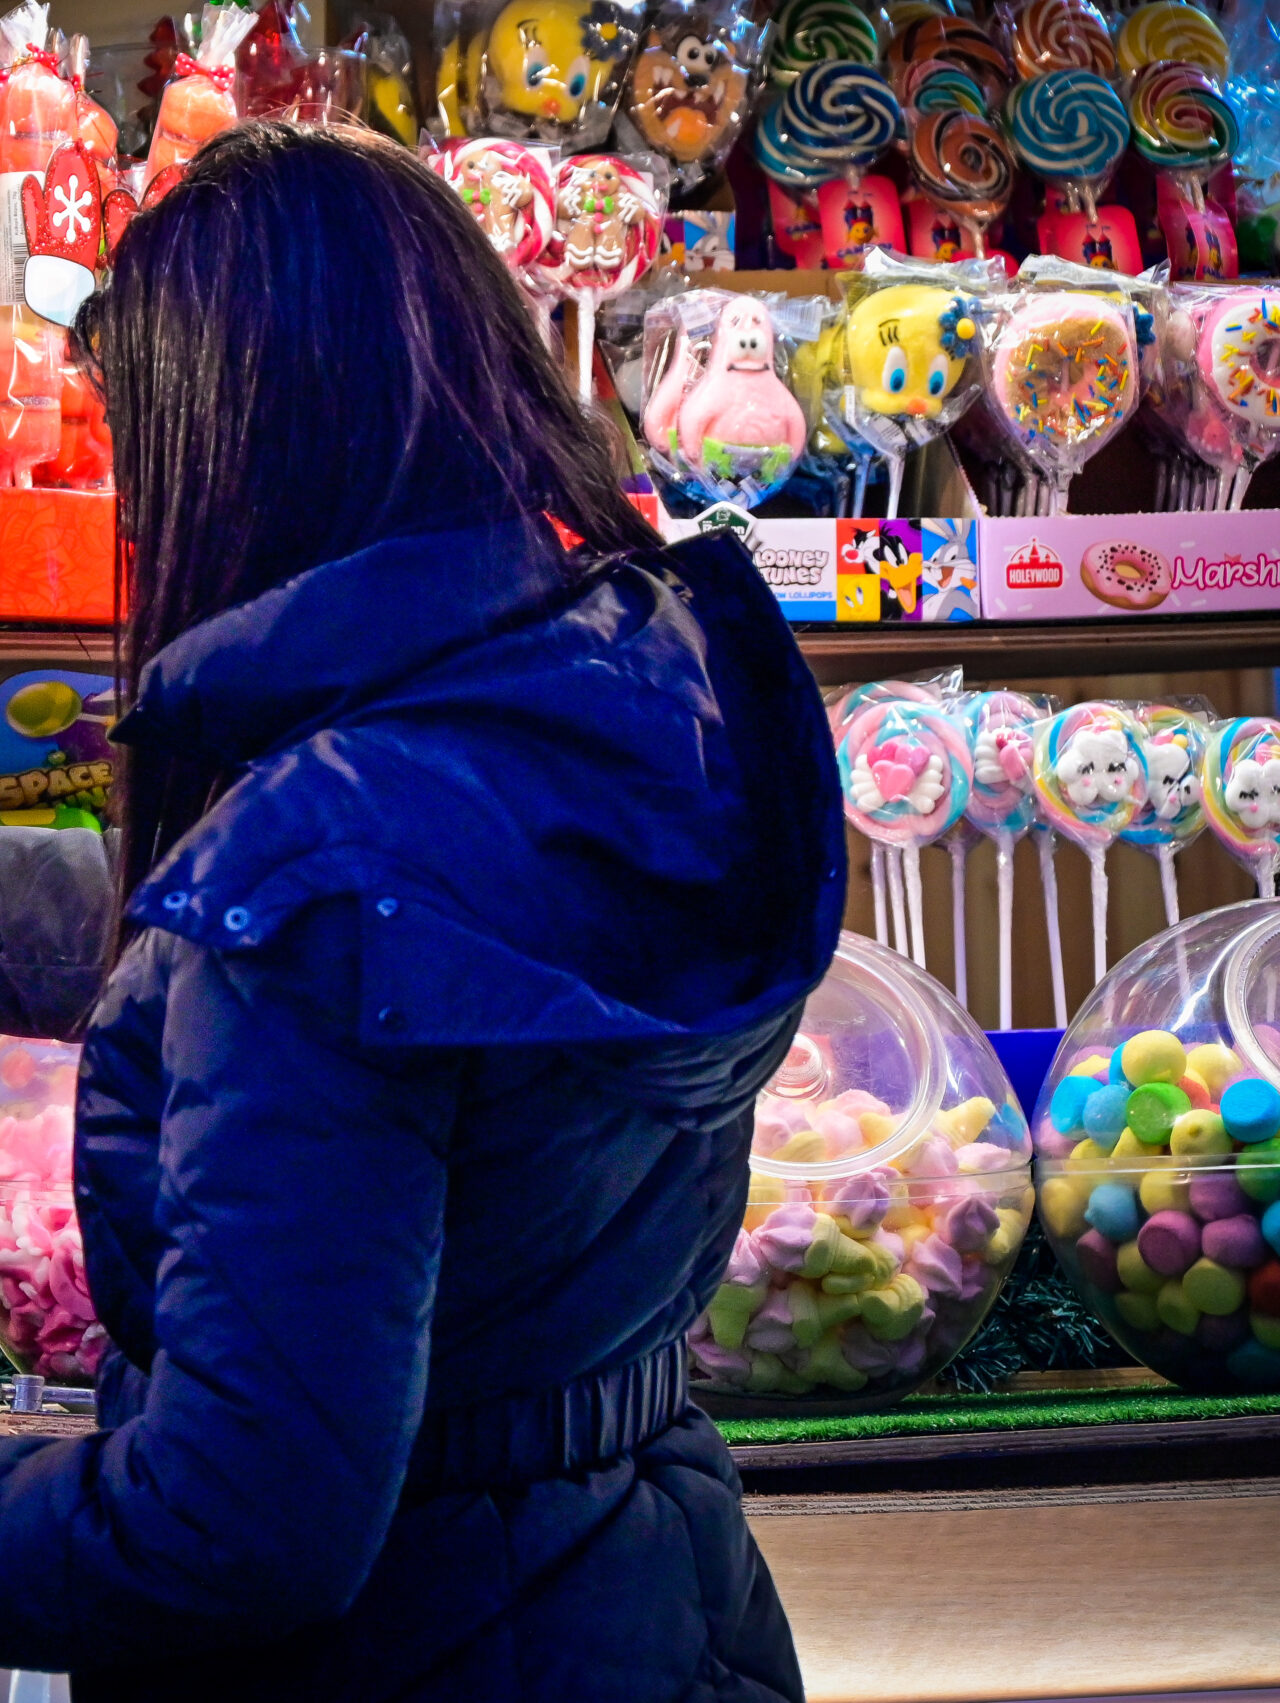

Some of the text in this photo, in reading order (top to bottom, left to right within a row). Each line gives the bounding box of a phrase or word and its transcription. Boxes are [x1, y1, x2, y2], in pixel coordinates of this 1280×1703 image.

[754, 549, 828, 568] LOONEY
[760, 566, 822, 586] TUNES
[1009, 567, 1060, 584] HOLEYWOOD
[1171, 553, 1280, 591] Marsh
[788, 591, 833, 599] LOLLIPOPS
